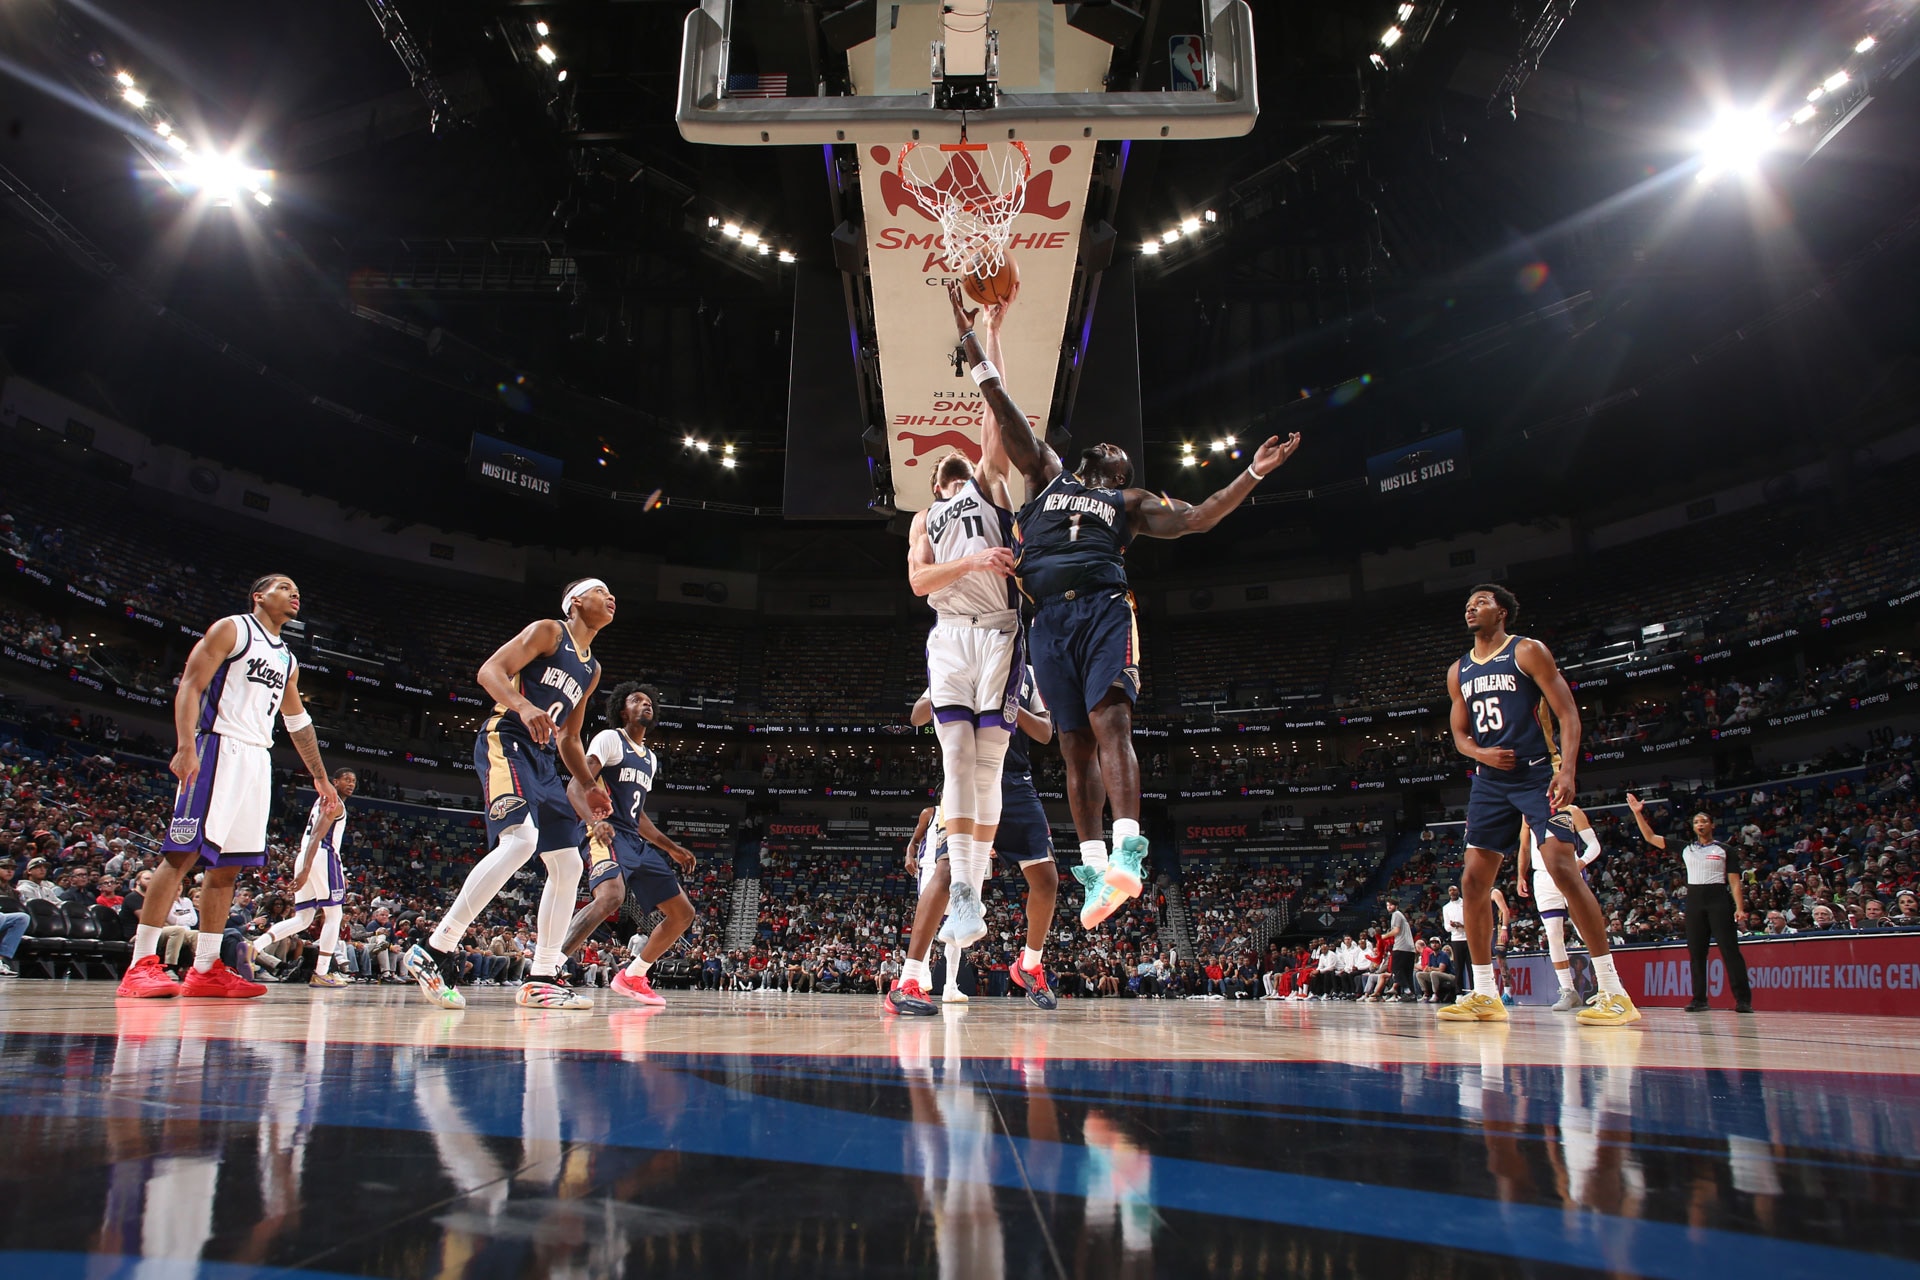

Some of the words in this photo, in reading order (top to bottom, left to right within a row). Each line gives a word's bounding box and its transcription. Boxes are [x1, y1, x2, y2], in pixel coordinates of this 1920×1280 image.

[482, 461, 518, 484] HUSTLE
[520, 474, 550, 494] STATS
[1380, 470, 1418, 493] HUSTLE
[1420, 459, 1454, 480] STATS
[1043, 494, 1070, 513] NEW
[1070, 496, 1116, 528] ORLEANS
[962, 516, 984, 539] 11
[1068, 514, 1082, 542] 1
[24, 567, 52, 586] entergy
[67, 584, 76, 594] We
[76, 590, 94, 604] power
[1888, 598, 1900, 608] We
[135, 613, 164, 628] entergy
[1832, 610, 1867, 626] entergy
[180, 626, 191, 634] We
[192, 628, 204, 638] pow
[1762, 633, 1784, 646] power
[4, 646, 16, 656] We
[17, 652, 40, 666] power
[1702, 650, 1732, 662] entergy
[246, 657, 284, 690] Kings
[540, 666, 569, 690] NEW
[1638, 666, 1660, 677] power
[78, 675, 104, 690] entergy
[355, 675, 380, 686] entergy
[1474, 674, 1516, 694] ORLEANS
[1579, 678, 1608, 689] entergy
[1904, 682, 1918, 692] We
[395, 682, 404, 690] We
[405, 686, 422, 694] power
[116, 687, 126, 696] We
[128, 691, 150, 704] power
[458, 696, 482, 706] entergy
[1860, 692, 1890, 706] entergy
[1399, 709, 1417, 717] power
[1472, 697, 1504, 734] 25
[1768, 718, 1782, 726] We
[1784, 712, 1809, 725] power
[659, 720, 682, 728] entergy
[1347, 716, 1372, 724] entergy
[1720, 726, 1750, 738] entergy
[356, 745, 377, 755] power
[1656, 741, 1678, 751] power
[414, 756, 438, 767] entergy
[1594, 751, 1624, 761] entergy
[618, 768, 636, 782] NEW
[1412, 776, 1432, 784] power
[1300, 786, 1320, 794] power
[1358, 781, 1384, 789] entergy
[832, 789, 857, 797] entergy
[1249, 788, 1274, 796] entergy
[630, 790, 641, 819] 2
[850, 806, 868, 819] 106
[1274, 805, 1294, 818] 108
[769, 824, 820, 835] SEATGEEK
[1186, 825, 1248, 839] SEATGEEK
[1644, 961, 1694, 997] MAR
[1748, 965, 1830, 990] SMOOTHIE
[1834, 964, 1882, 990] KING
